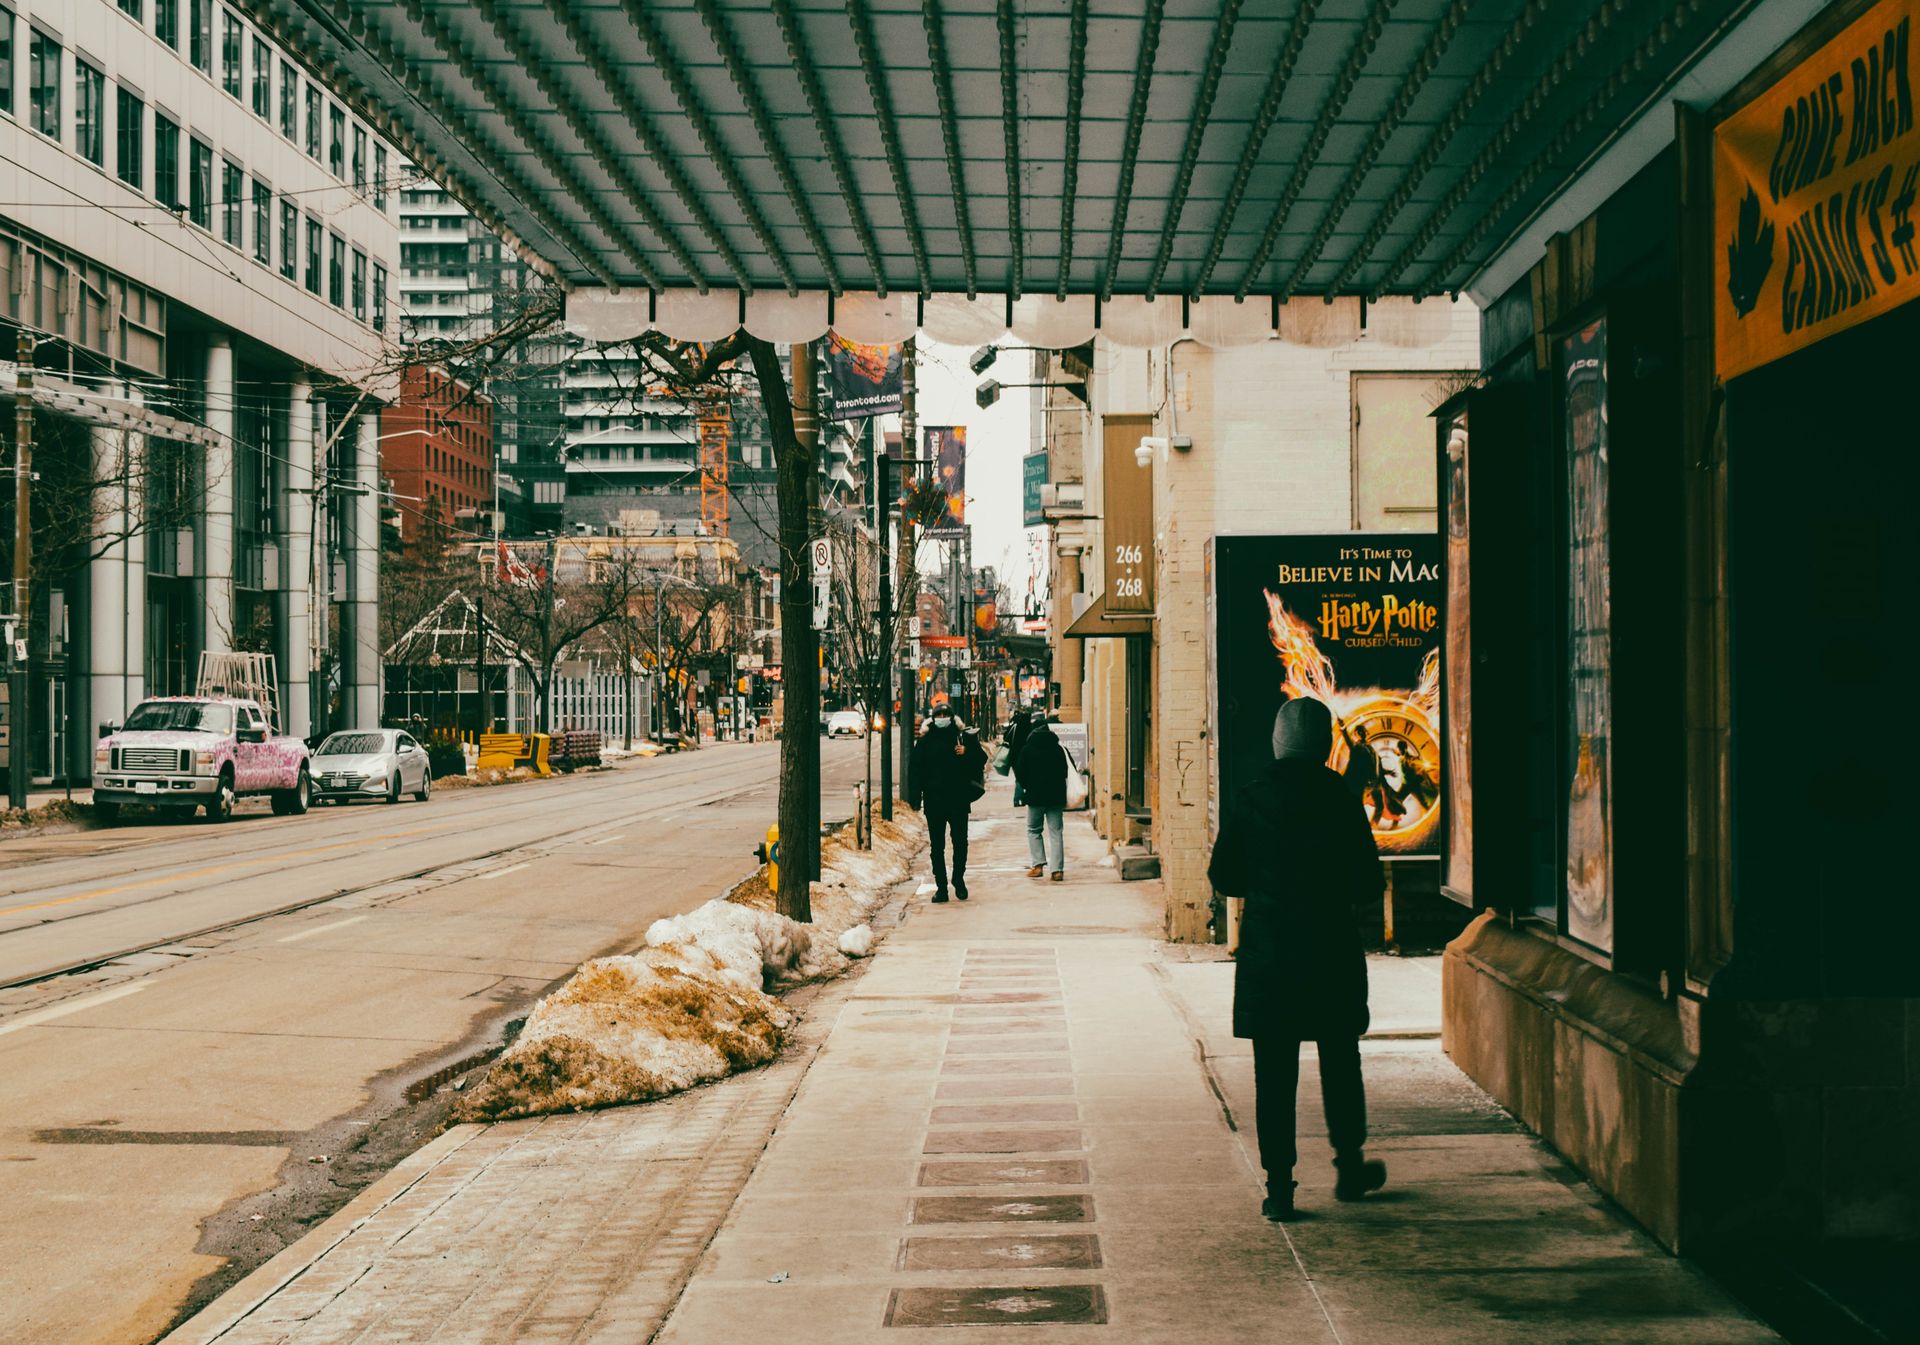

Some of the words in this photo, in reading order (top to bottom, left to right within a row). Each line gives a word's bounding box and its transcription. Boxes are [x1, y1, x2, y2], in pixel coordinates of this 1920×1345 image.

[1769, 72, 1843, 205] COME
[1845, 15, 1914, 167] BACK
[1782, 164, 1896, 335] CANADA'S
[1116, 545, 1142, 564] 266
[1340, 548, 1359, 560] IT'S
[1361, 547, 1392, 560] TIME
[1395, 548, 1413, 559] TO
[1278, 564, 1353, 584] BELIEVE
[1359, 566, 1381, 582] IN
[1116, 578, 1142, 597] 268
[1317, 599, 1382, 641] Harry
[1382, 594, 1439, 643] Potte
[1345, 637, 1386, 648] CURSED
[1389, 637, 1423, 647] CHILD
